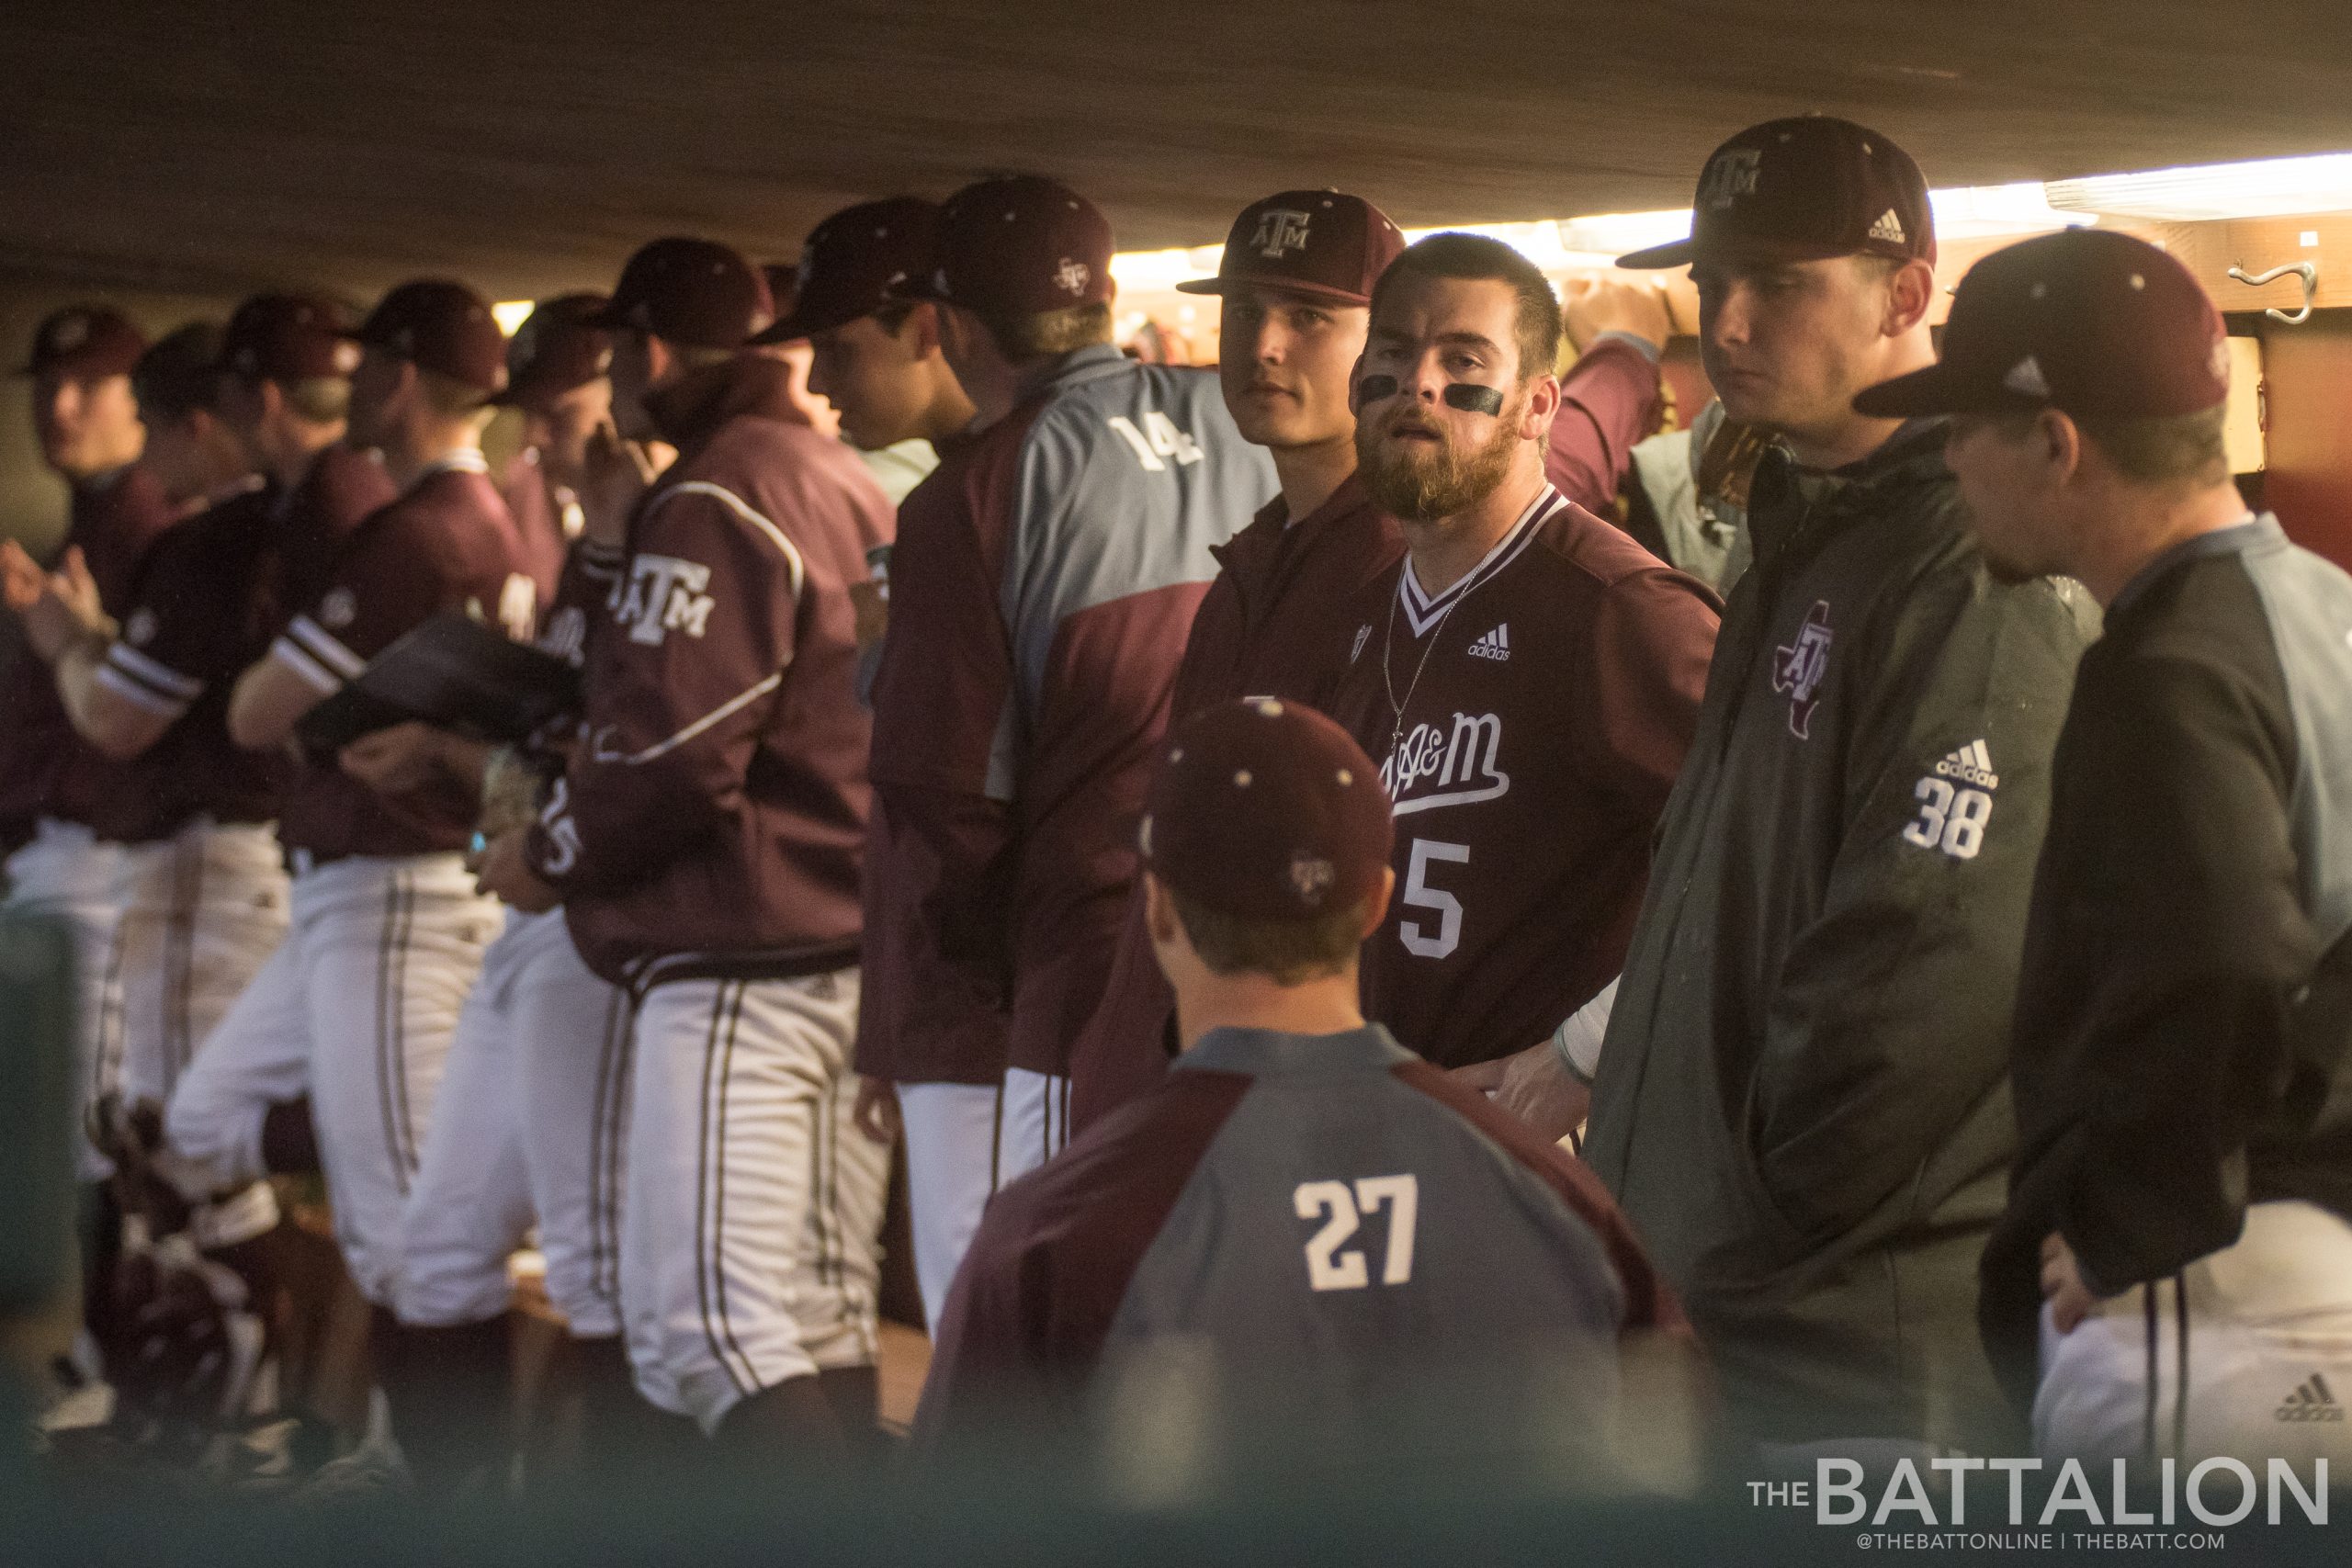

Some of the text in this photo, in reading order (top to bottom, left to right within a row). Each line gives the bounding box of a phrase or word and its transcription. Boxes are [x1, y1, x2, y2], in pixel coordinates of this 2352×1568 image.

[1107, 412, 1204, 471] 14
[1467, 644, 1510, 661] adidas
[1936, 761, 1999, 789] adidas
[1903, 776, 1993, 859] 38
[1400, 838, 1470, 959] 5
[1294, 1173, 1419, 1292] 27
